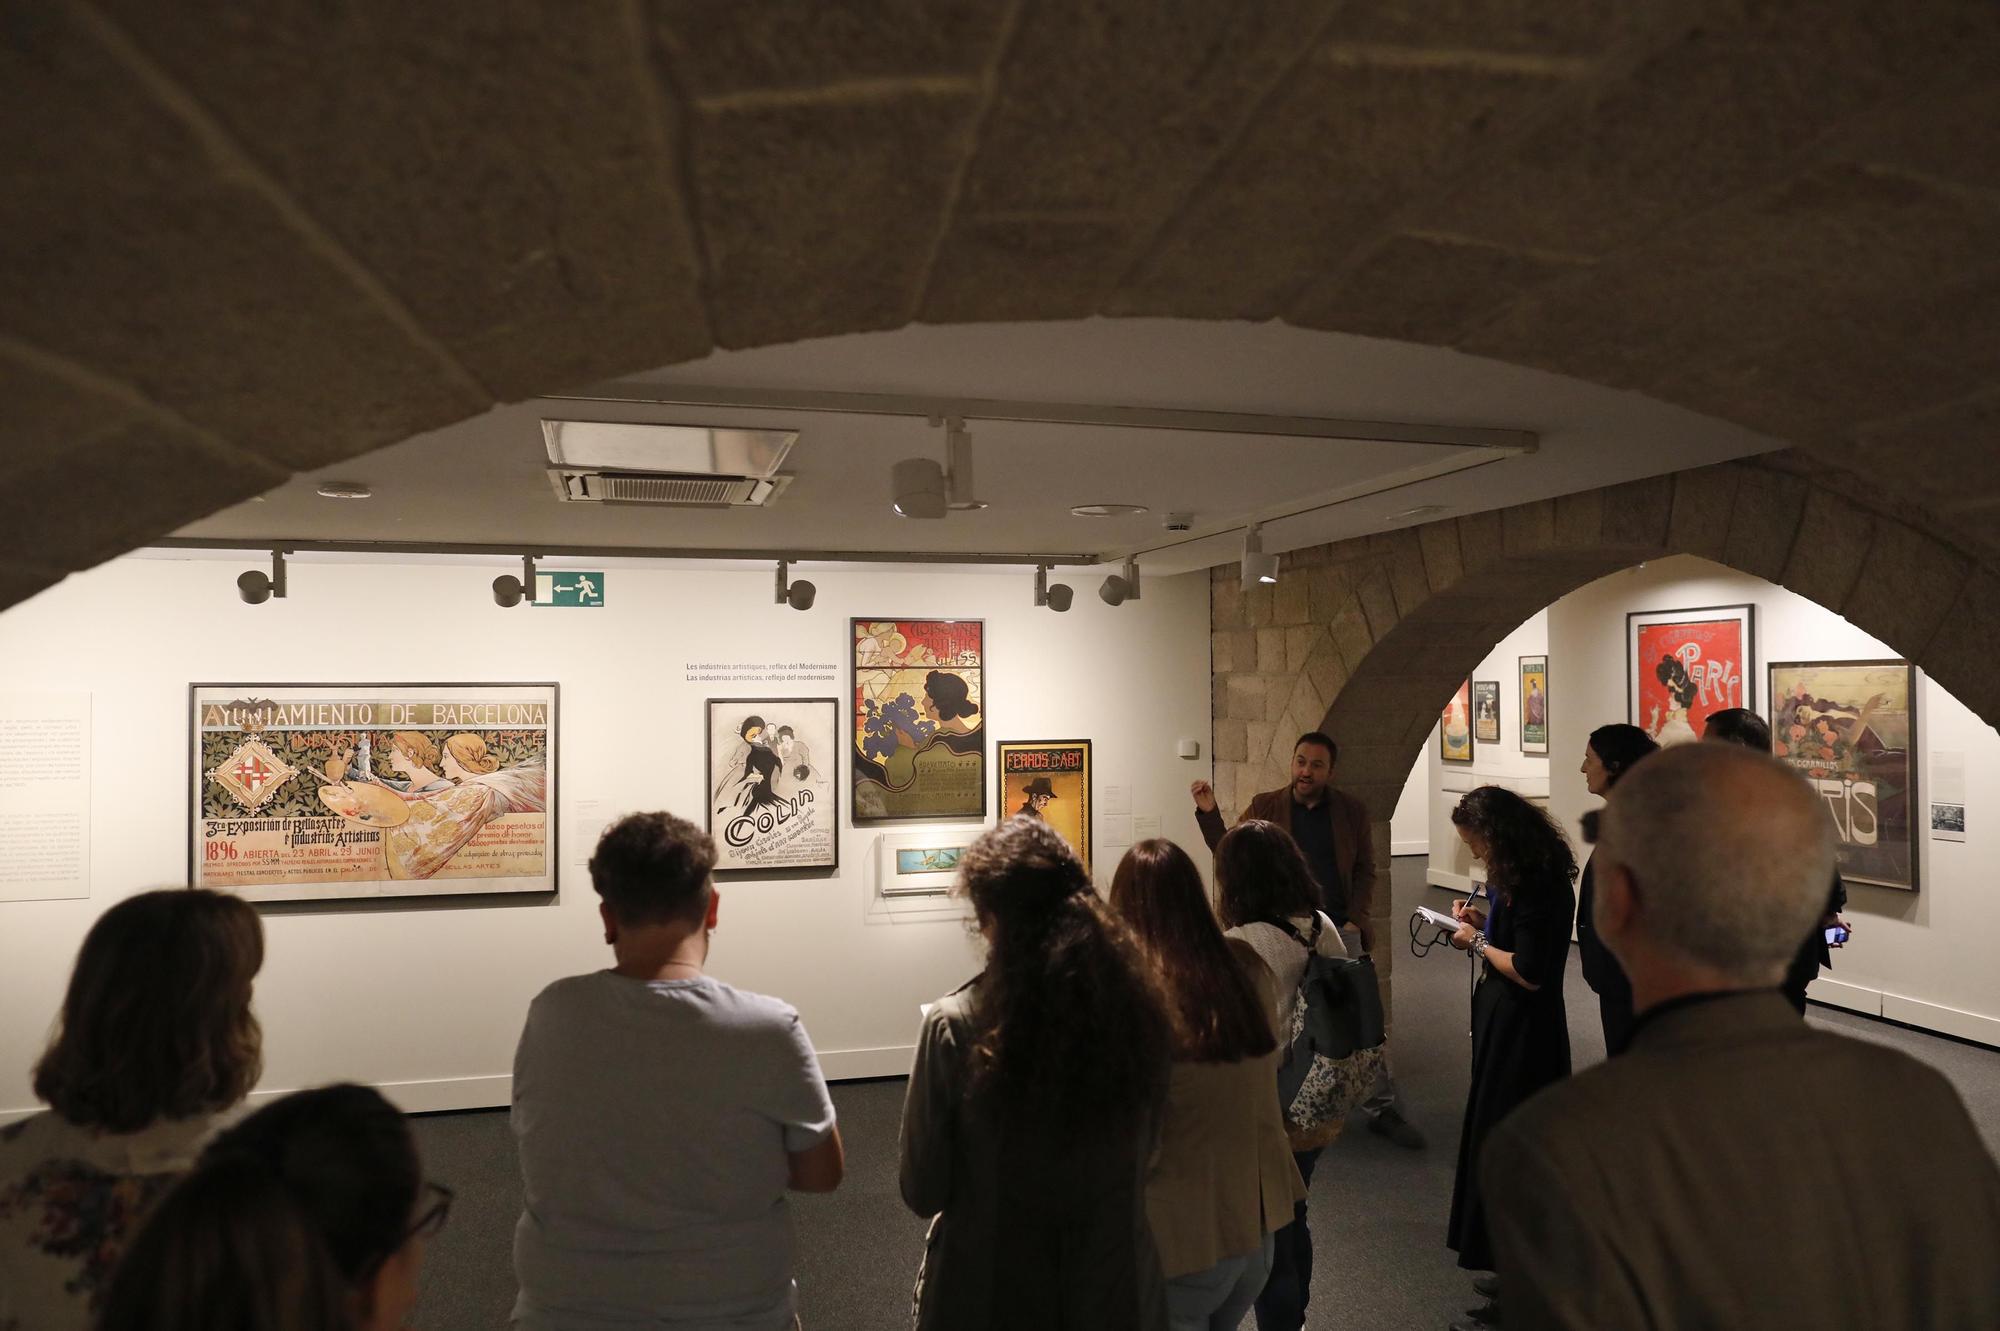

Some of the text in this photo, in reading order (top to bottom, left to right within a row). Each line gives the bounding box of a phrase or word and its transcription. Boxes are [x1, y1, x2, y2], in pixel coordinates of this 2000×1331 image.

[765, 674, 785, 682] reflejo
[203, 704, 546, 726] AYUNTAMIENTO DE BARCELONA
[485, 732, 546, 746] ARTE
[1006, 752, 1049, 769] FERROS
[282, 817, 292, 831] de
[293, 819, 320, 834] Bellas
[320, 816, 346, 833] Artes
[506, 822, 537, 832] pesetas
[537, 821, 544, 830] al
[291, 831, 335, 848] Industrias
[501, 830, 510, 838] de
[206, 841, 238, 860] 1896
[243, 849, 279, 859] ABIERTA
[292, 849, 304, 857] 23
[308, 848, 331, 857] ABRIL
[356, 847, 380, 855] JUNIO
